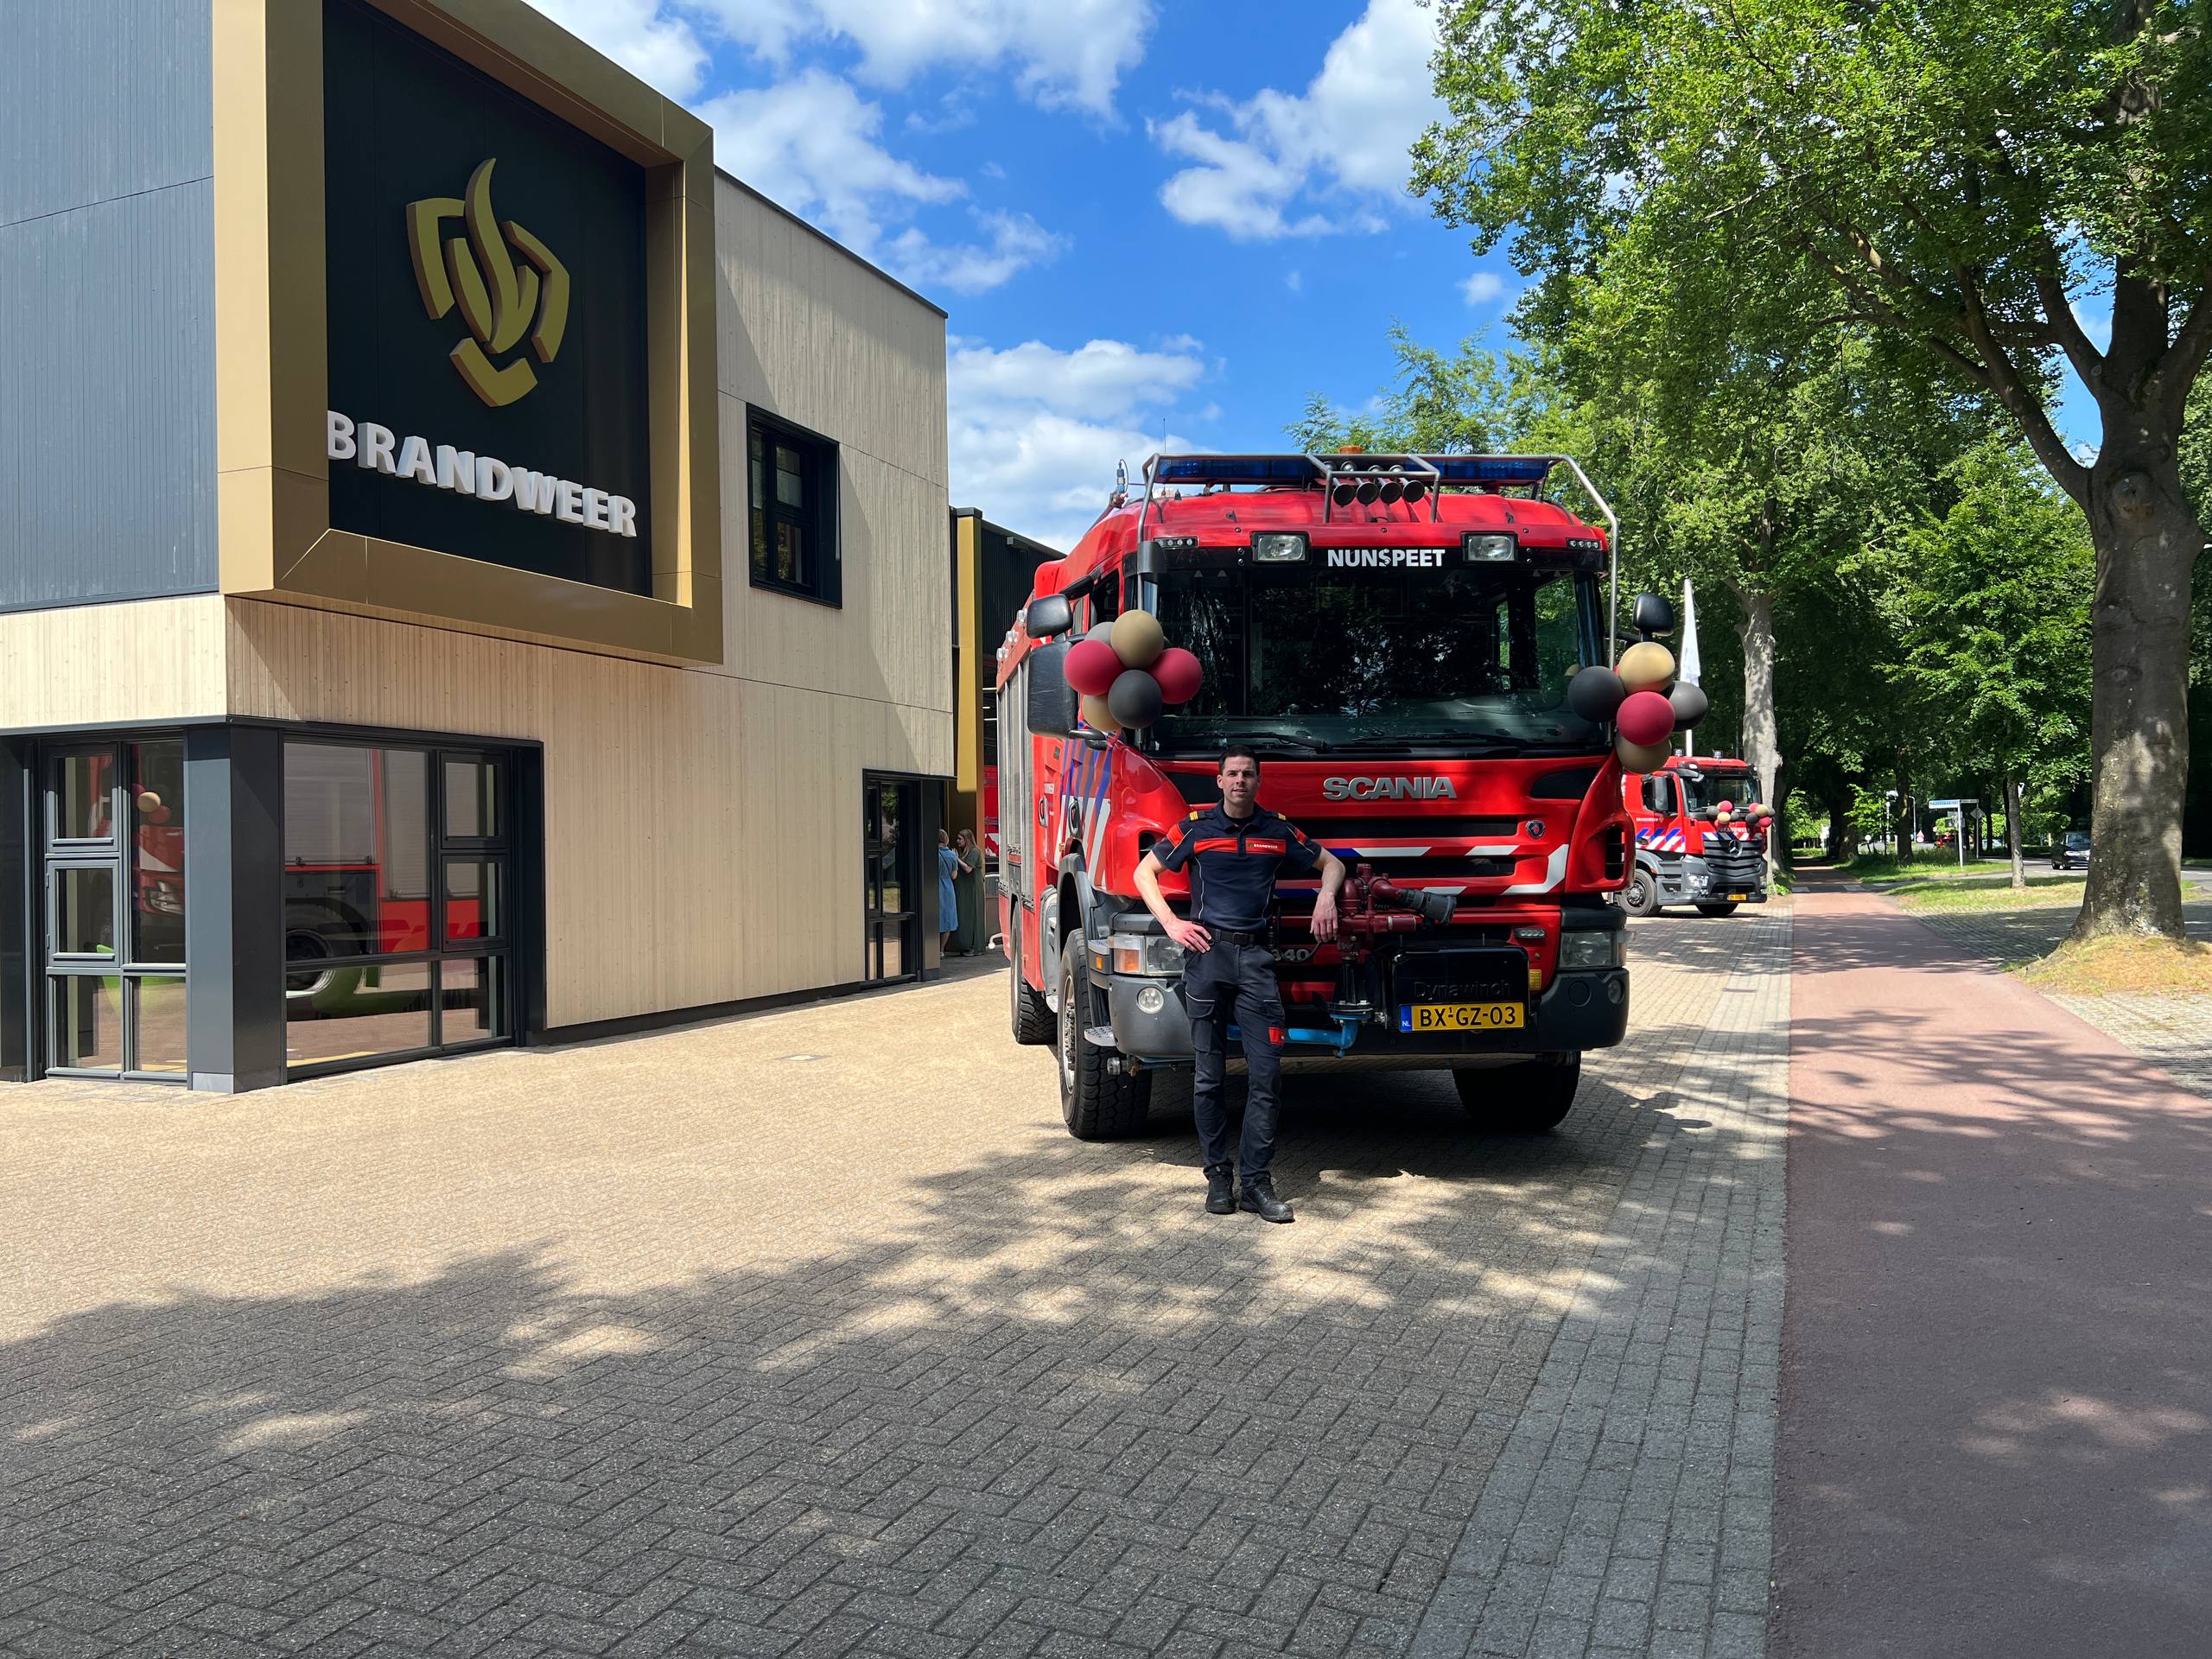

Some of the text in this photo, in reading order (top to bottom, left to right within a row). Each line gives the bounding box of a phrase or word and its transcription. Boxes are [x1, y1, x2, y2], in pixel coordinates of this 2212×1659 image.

[327, 410, 637, 537] BRANDWEER
[1327, 549, 1446, 567] NUNSPEET
[1323, 777, 1458, 800] SCANIA
[1414, 978, 1511, 1001] Dynawinch
